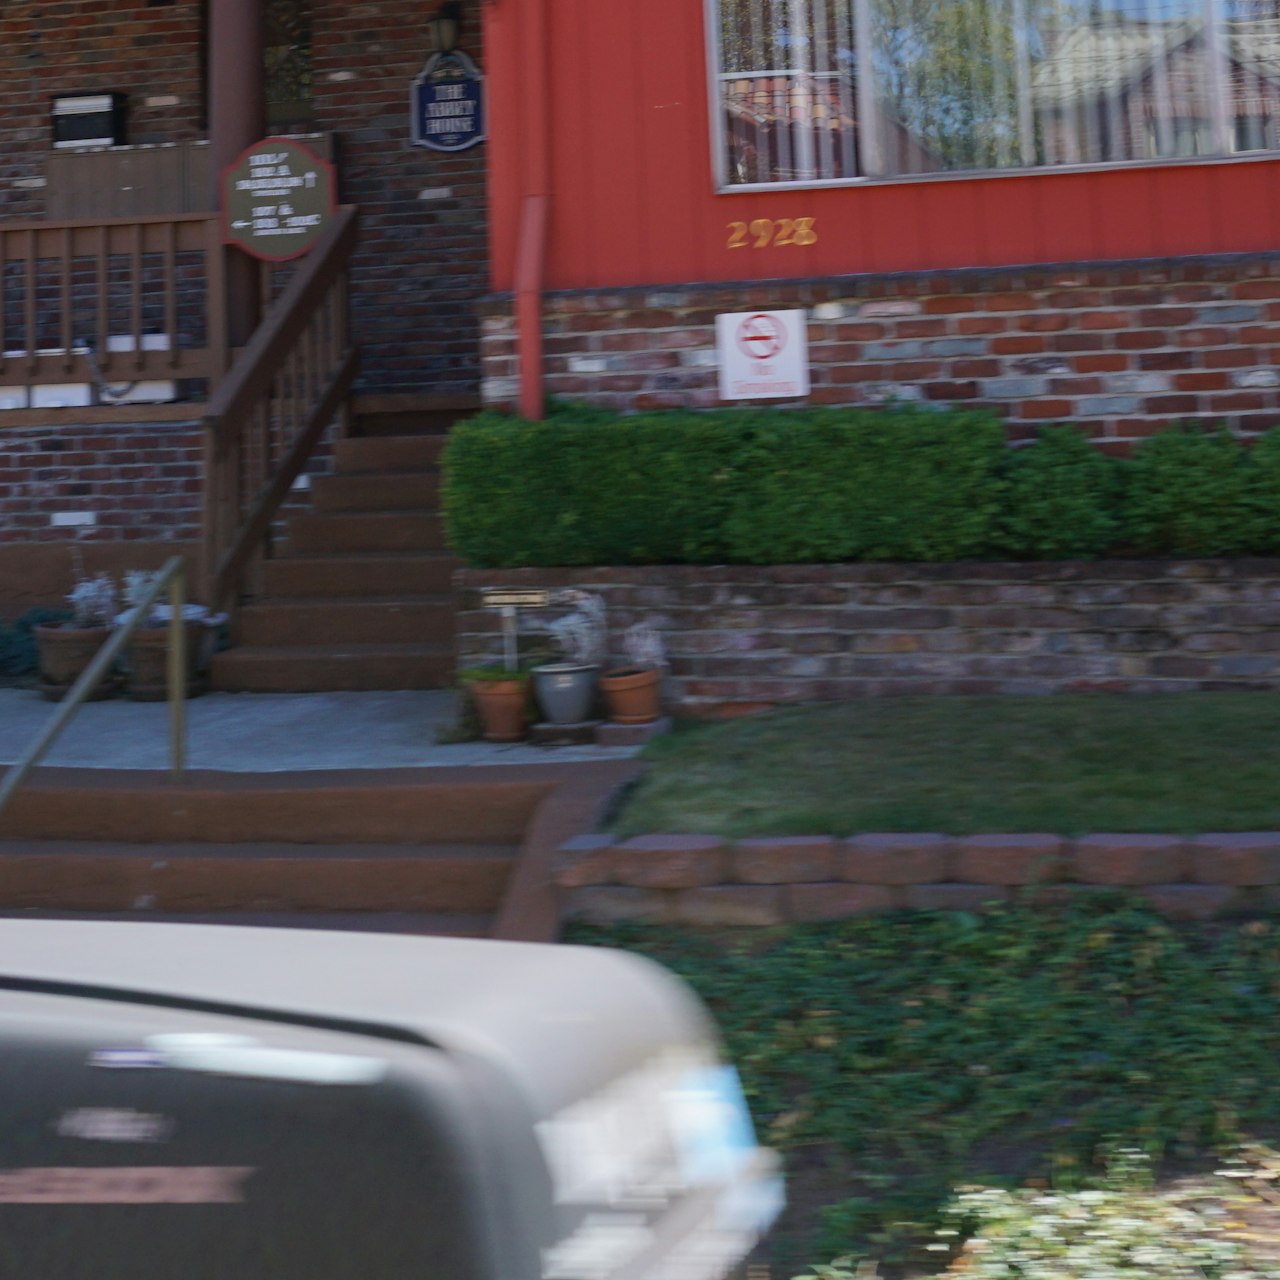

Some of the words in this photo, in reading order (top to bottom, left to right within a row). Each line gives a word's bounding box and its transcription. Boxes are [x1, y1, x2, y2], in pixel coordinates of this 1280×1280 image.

[432, 83, 465, 101] THE
[425, 100, 476, 118] ABBEY
[425, 117, 474, 134] HOUSE
[726, 216, 818, 249] 2928
